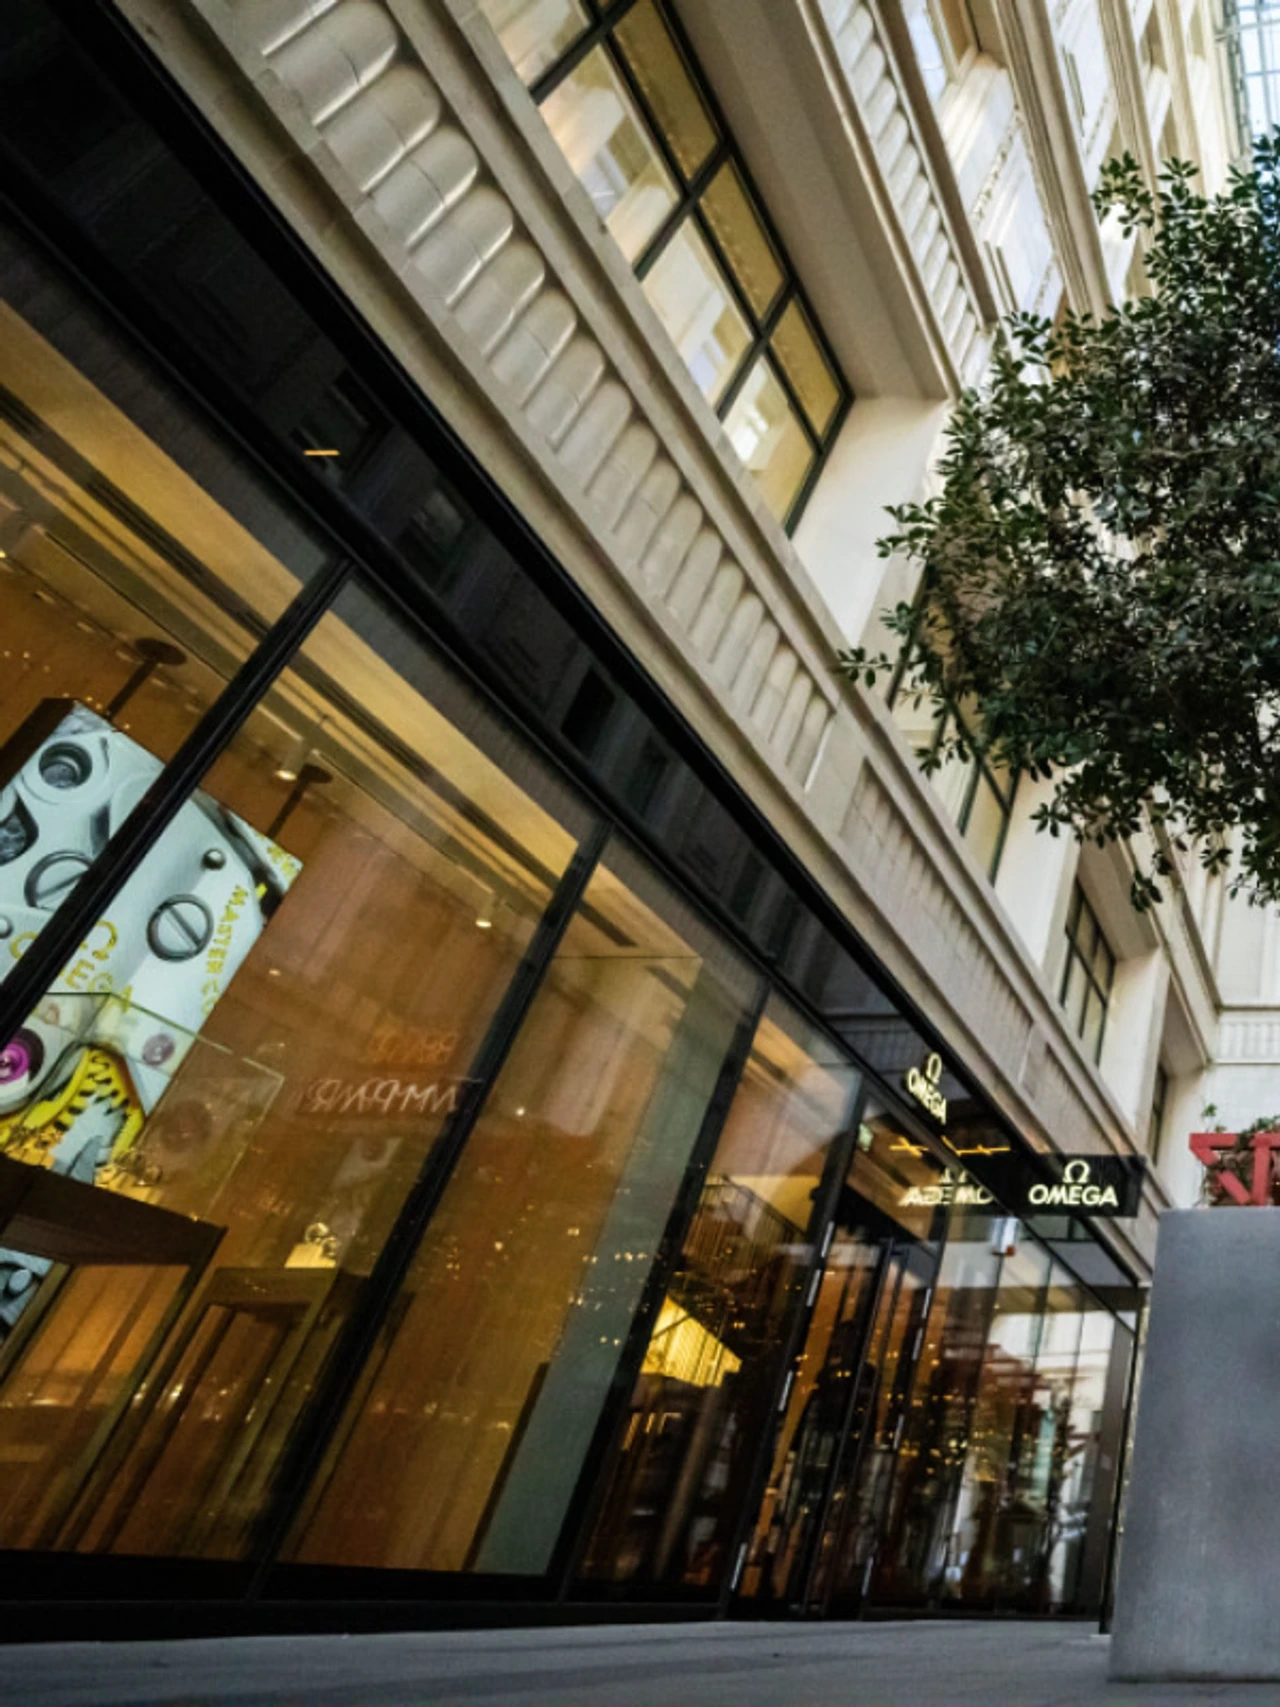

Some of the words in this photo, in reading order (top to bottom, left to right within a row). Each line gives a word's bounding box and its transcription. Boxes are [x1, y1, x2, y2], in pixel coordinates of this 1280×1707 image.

[205, 884, 249, 974] MASTER
[907, 1066, 947, 1125] OMEGA
[1028, 1184, 1118, 1207] OMEGA
